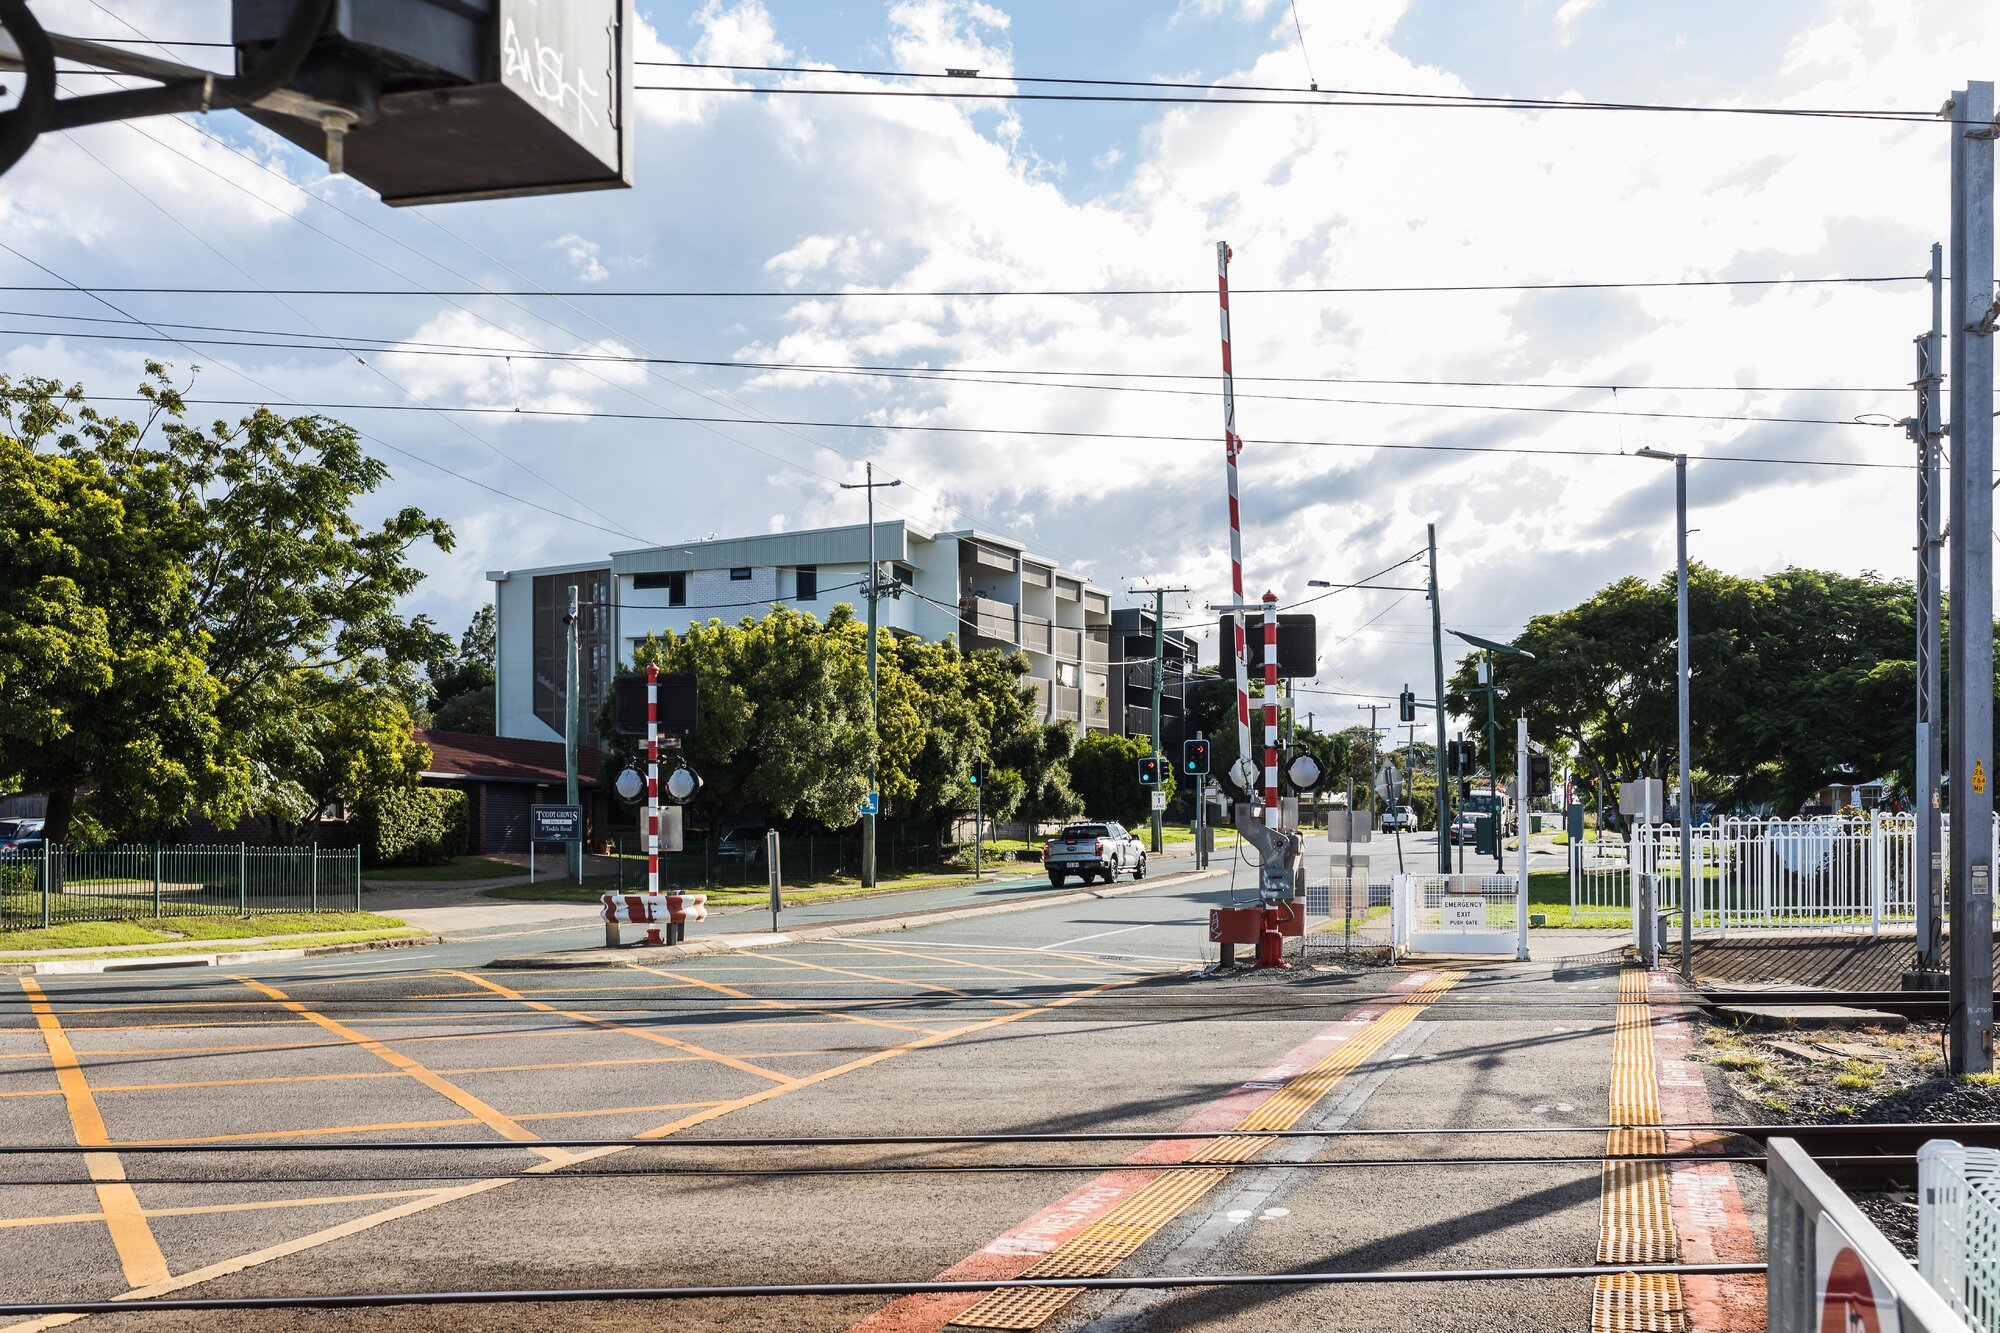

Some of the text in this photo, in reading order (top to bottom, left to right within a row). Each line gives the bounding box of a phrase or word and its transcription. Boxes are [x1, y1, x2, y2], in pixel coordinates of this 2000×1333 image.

[557, 810, 578, 822] GROVES
[1016, 1186, 1126, 1240] FINES APPLY
